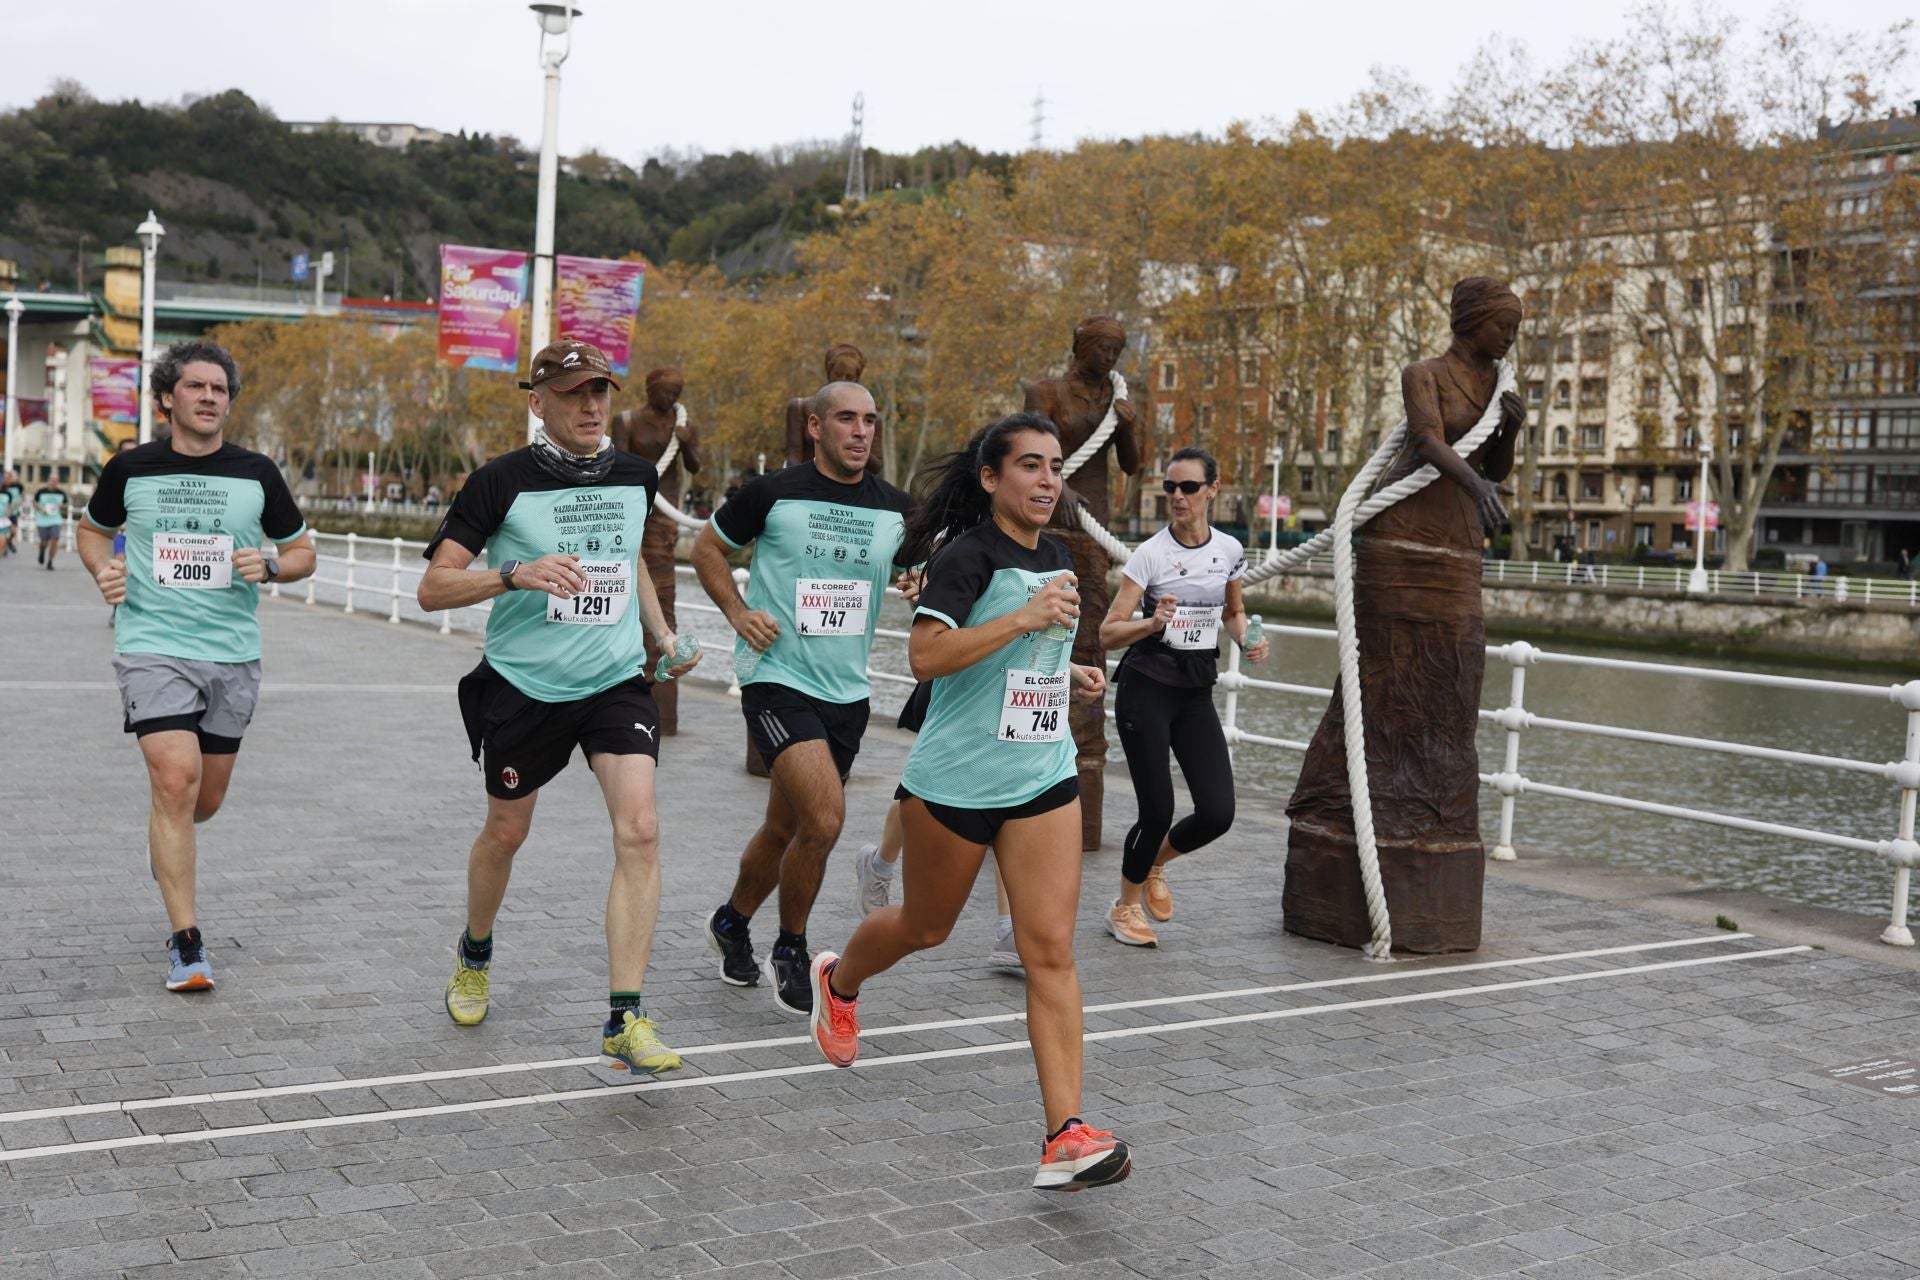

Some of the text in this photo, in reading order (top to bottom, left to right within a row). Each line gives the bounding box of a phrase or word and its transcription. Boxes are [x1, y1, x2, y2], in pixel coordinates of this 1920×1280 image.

[446, 264, 474, 281] Fair
[444, 281, 521, 309] Saturday
[158, 488, 228, 498] NAZIOARTEKO LASTERKETA
[575, 494, 603, 502] XXXVI
[157, 497, 228, 506] CARRERA INTERNACIONAL
[177, 506, 201, 514] SANTURCE
[553, 502, 624, 514] NAZIOARTEKO LASTERKETA
[829, 508, 854, 518] XXXVI
[555, 512, 626, 524] CARRERA INTERNACIONAL
[808, 513, 875, 528] NAZIOARTEKO LASTERKETA
[577, 524, 602, 534] SANTURCE
[808, 522, 874, 537] CARRERA INTERNACIONAL
[826, 533, 850, 544] SANTURCE
[850, 536, 854, 544] A
[159, 547, 190, 560] XXXVI
[557, 541, 579, 555] Stz
[805, 545, 826, 559] Stz
[173, 564, 211, 580] 2009
[581, 565, 618, 573] CORREO
[573, 596, 611, 615] 1291
[802, 595, 831, 608] XXXVI
[563, 615, 602, 623] kutxabank
[820, 611, 846, 628] 747
[1171, 620, 1193, 628] XXXVI
[1183, 630, 1202, 643] 142
[1025, 677, 1036, 685] EL
[1010, 691, 1047, 707] XXXVI
[1032, 710, 1058, 732] 748
[1016, 733, 1053, 741] kutxabank
